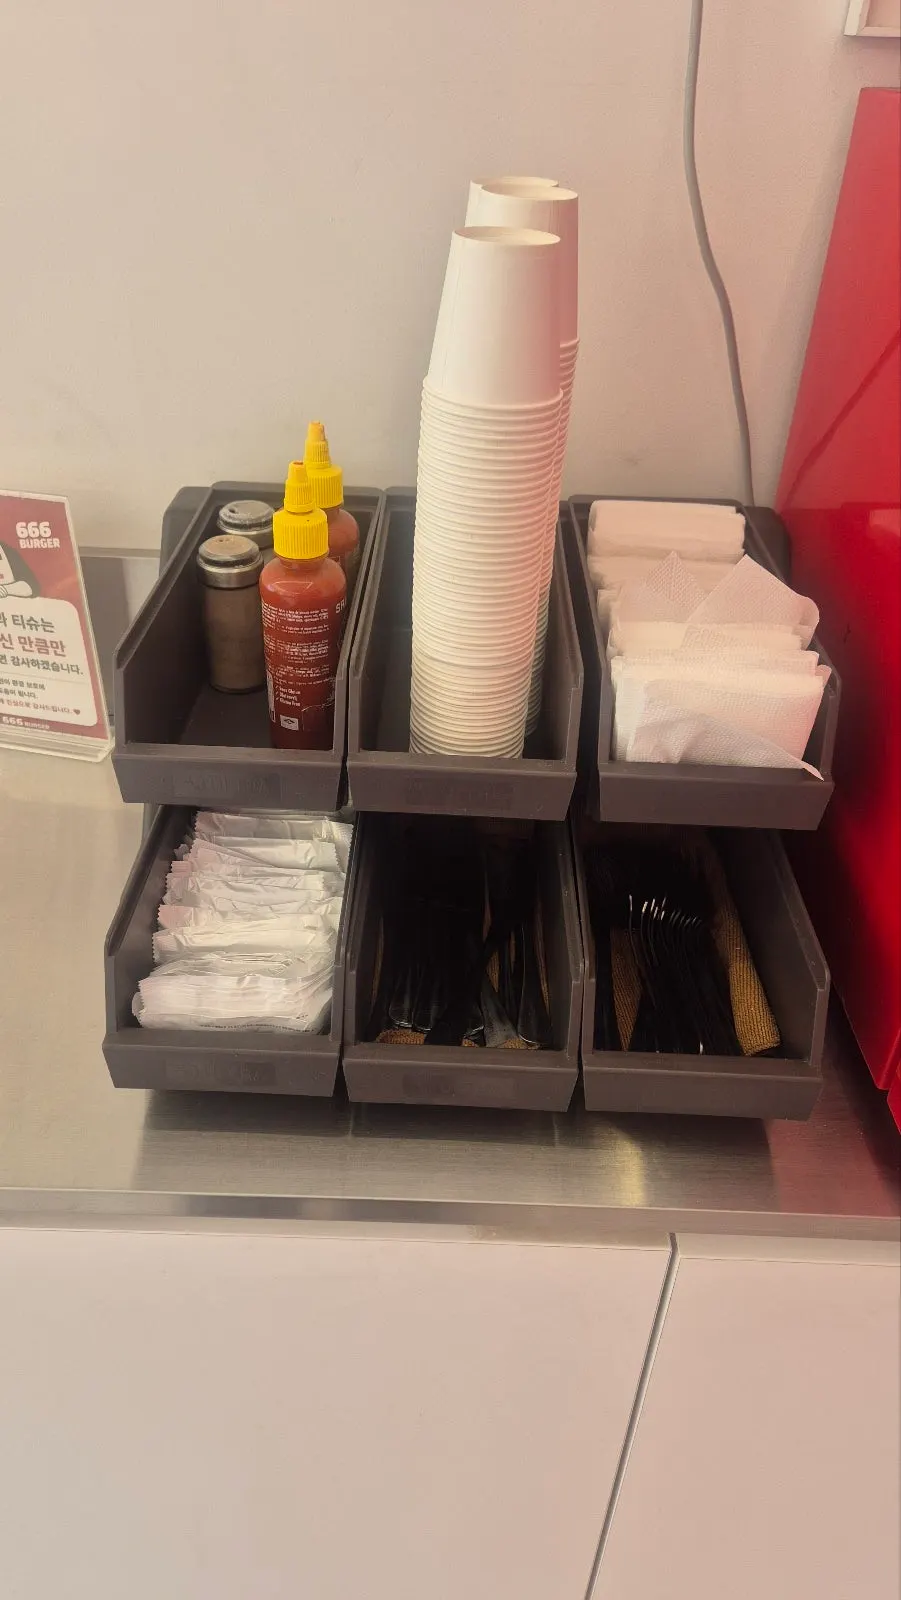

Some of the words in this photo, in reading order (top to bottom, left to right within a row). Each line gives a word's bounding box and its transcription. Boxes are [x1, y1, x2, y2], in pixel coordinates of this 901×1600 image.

[16, 521, 51, 538] 666
[19, 538, 60, 549] BURGER
[11, 614, 55, 633] 티슈는
[17, 636, 66, 657] 만큼만
[10, 656, 83, 675] 감사하겠습니다.
